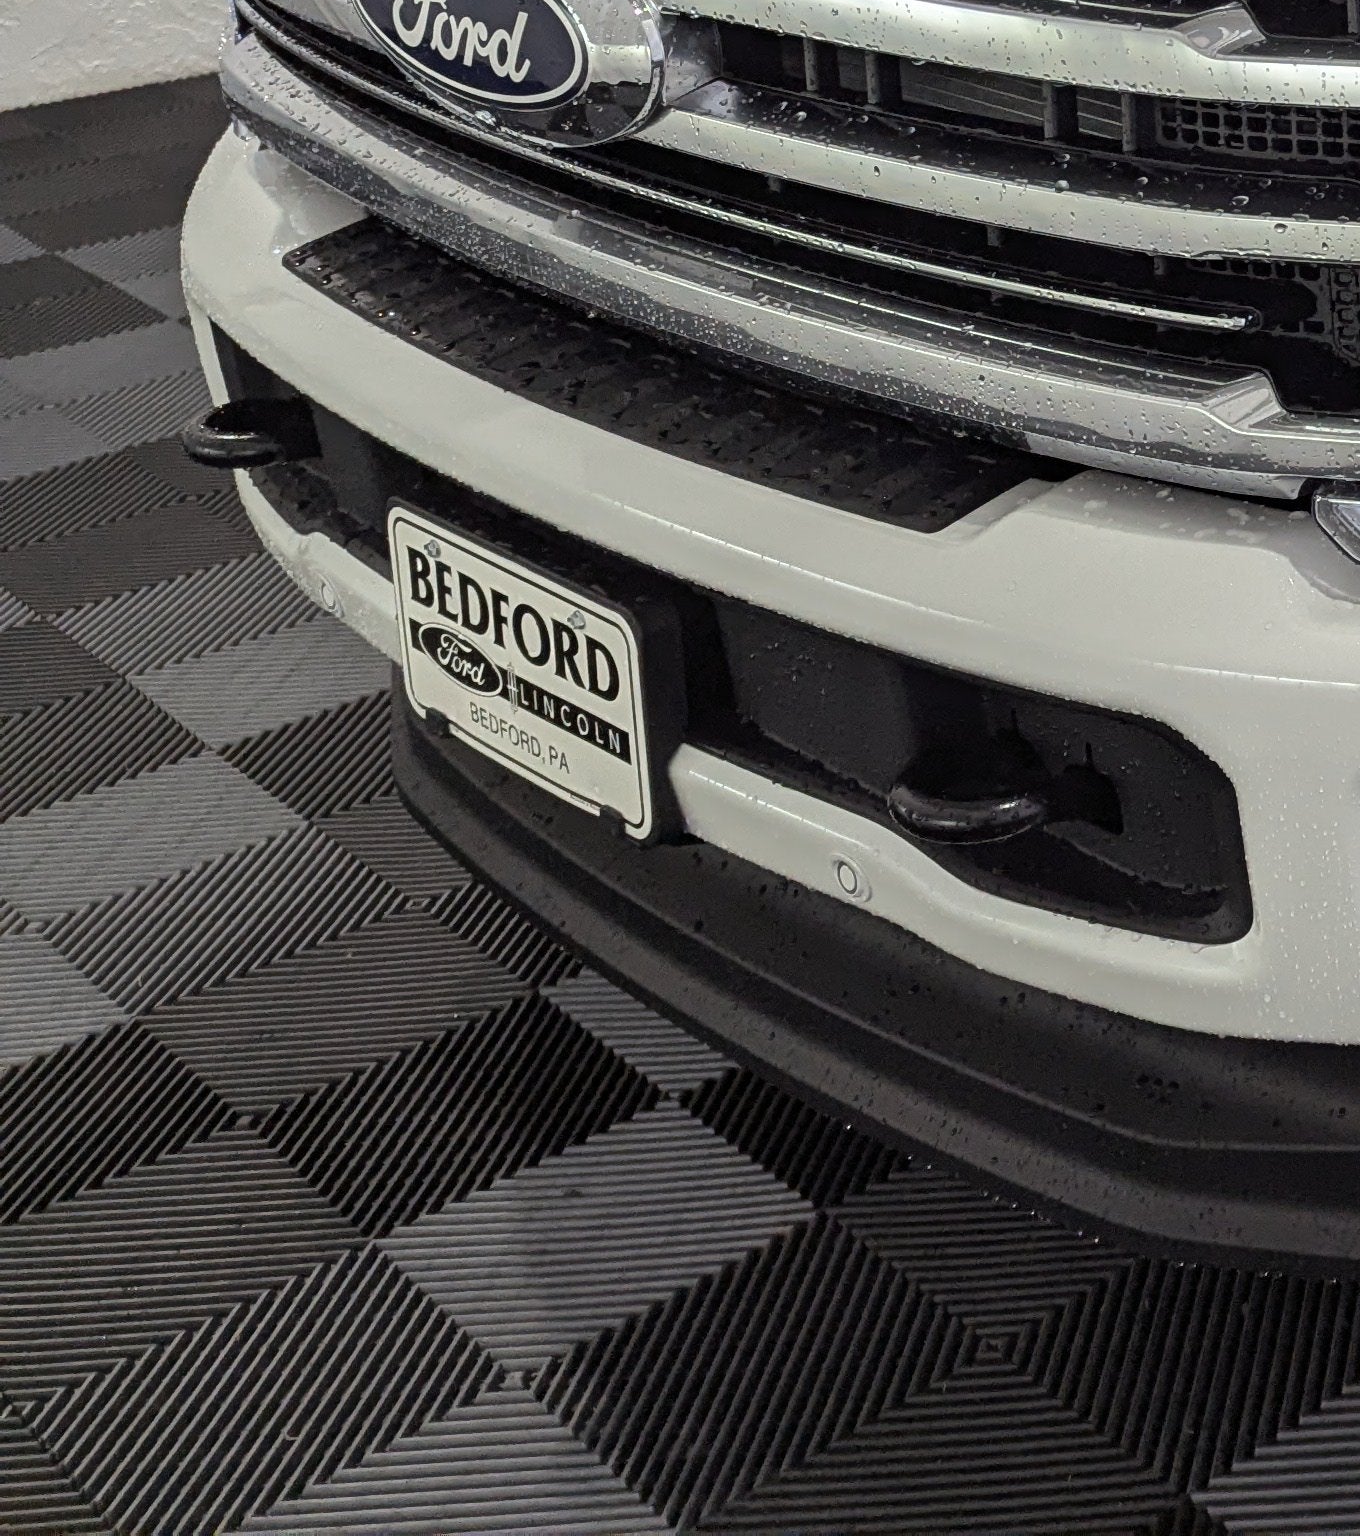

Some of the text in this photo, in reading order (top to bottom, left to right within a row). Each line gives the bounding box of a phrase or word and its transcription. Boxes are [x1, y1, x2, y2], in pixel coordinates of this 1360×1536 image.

[406, 545, 620, 701] BEDFORD
[436, 633, 622, 754] Ford LINCOLN
[548, 745, 570, 774] PA
